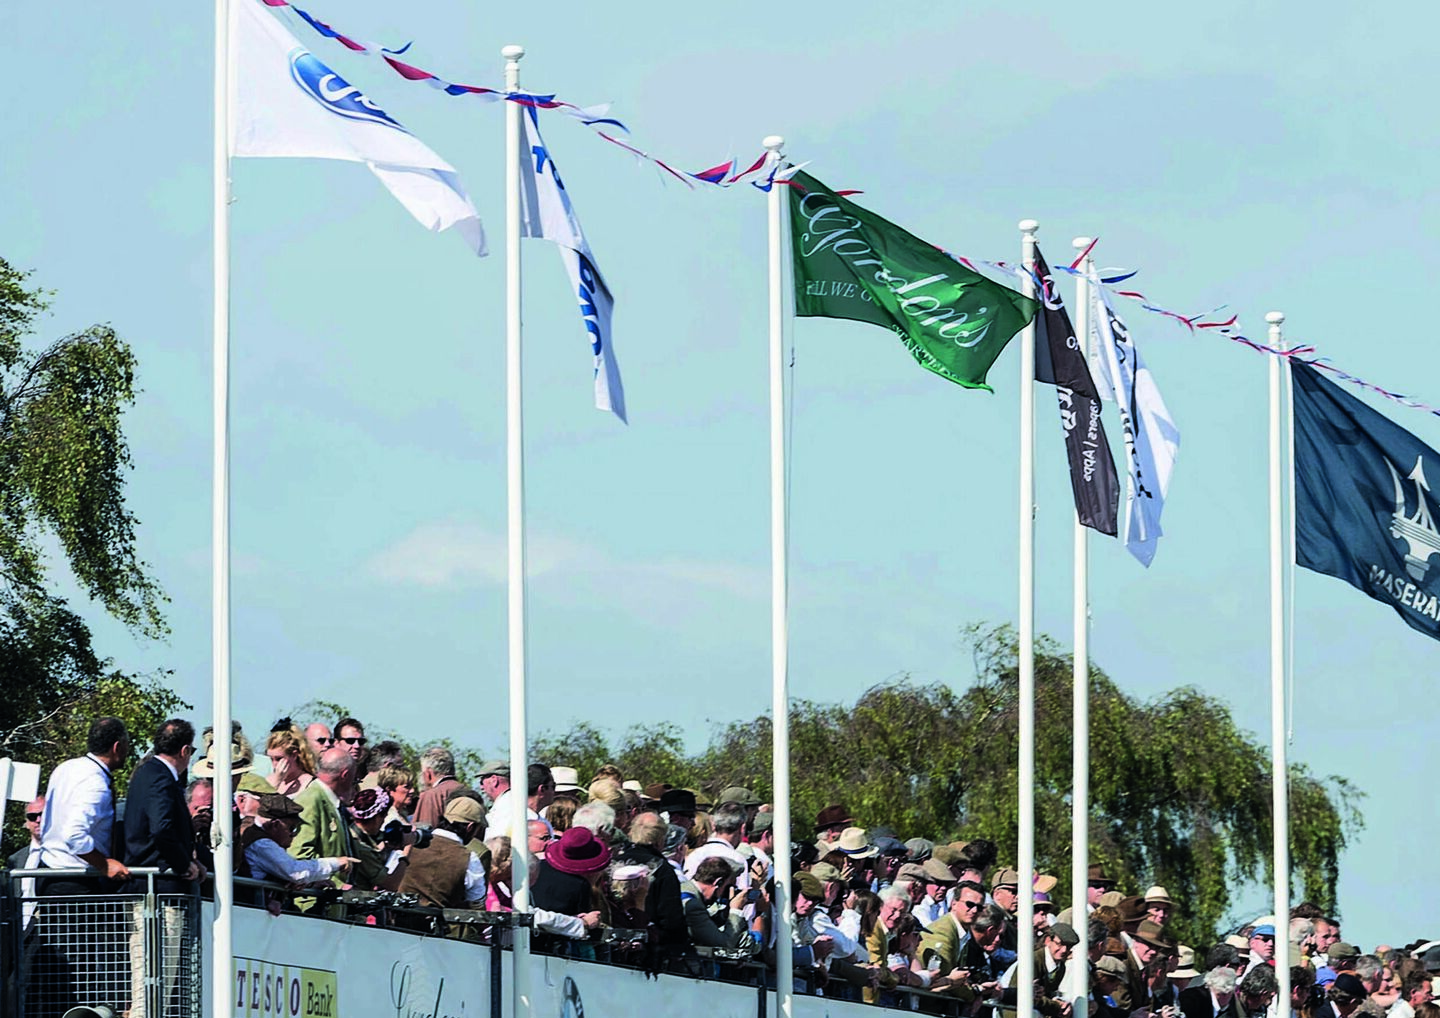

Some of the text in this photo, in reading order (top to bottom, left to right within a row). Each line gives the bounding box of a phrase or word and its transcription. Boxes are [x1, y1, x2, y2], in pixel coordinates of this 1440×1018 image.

[799, 192, 994, 348] Gordon's
[236, 970, 334, 1017] TESCO Bank
